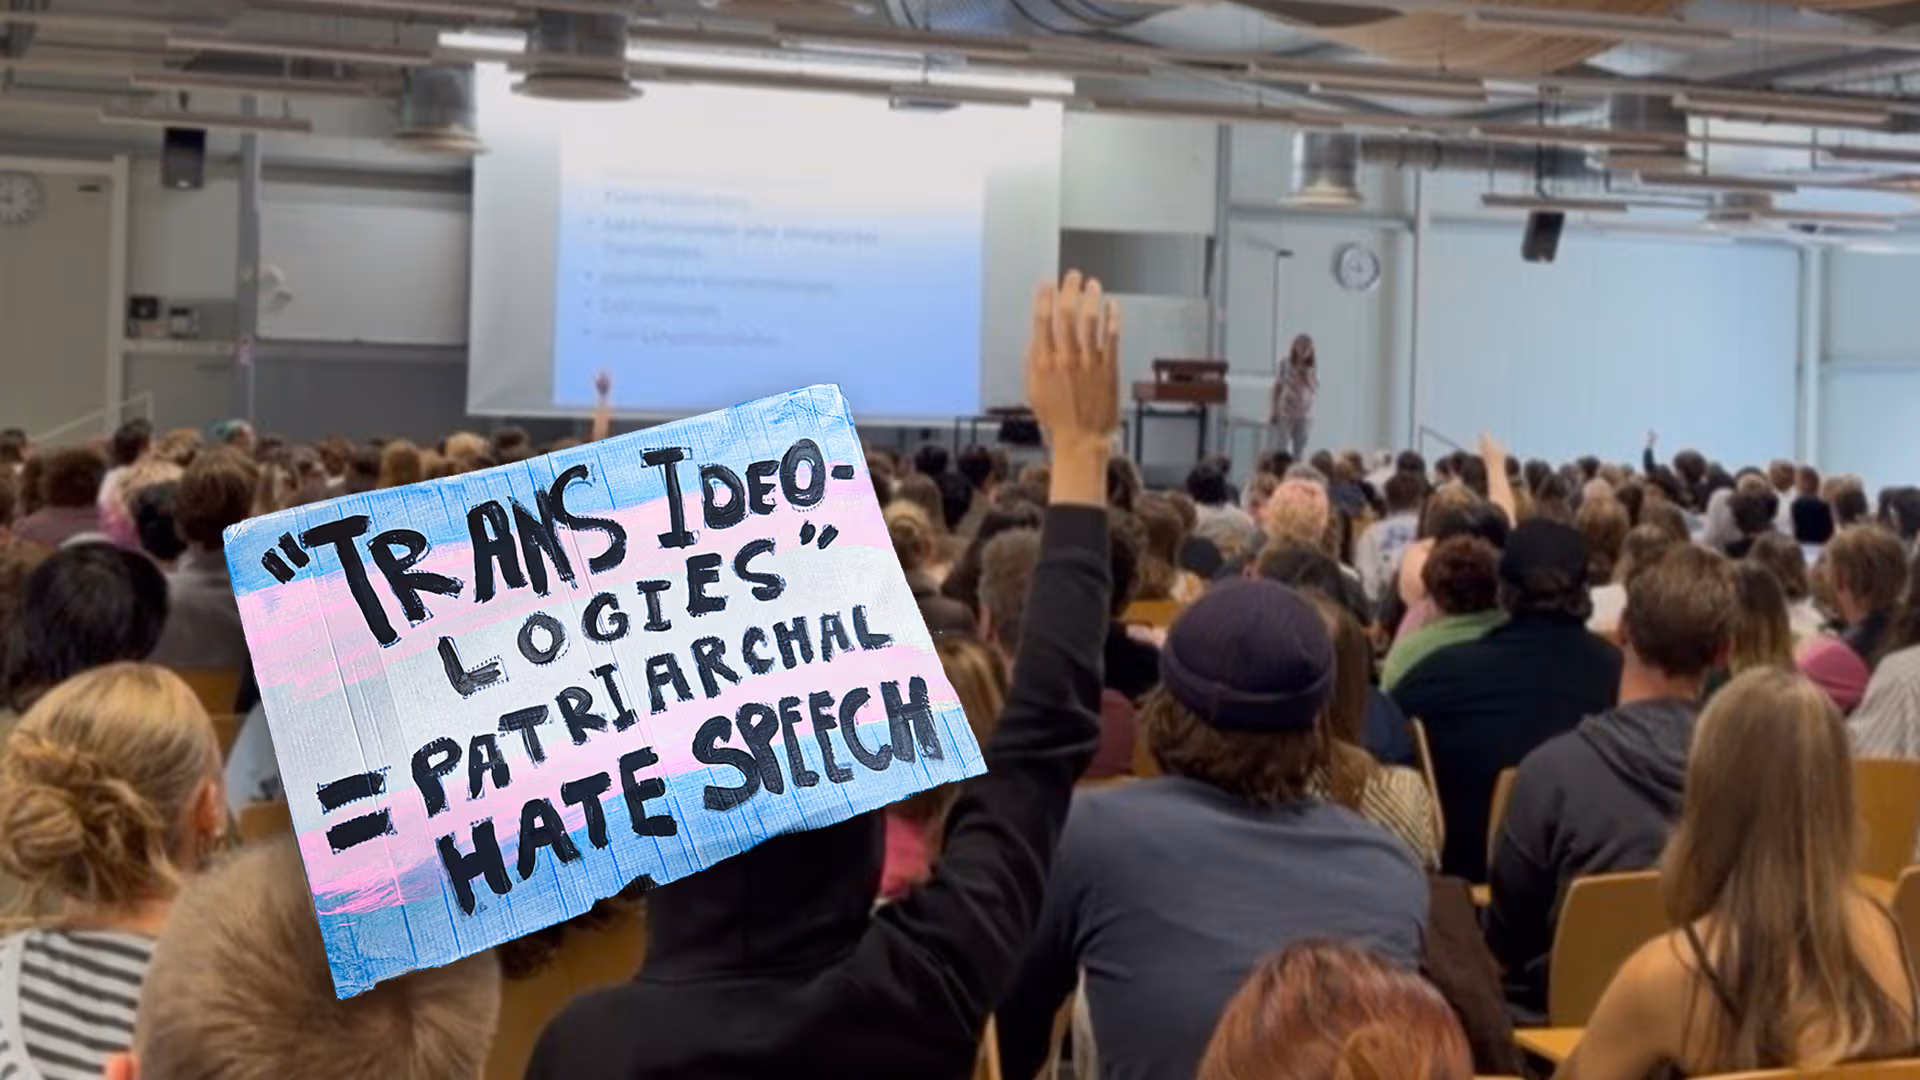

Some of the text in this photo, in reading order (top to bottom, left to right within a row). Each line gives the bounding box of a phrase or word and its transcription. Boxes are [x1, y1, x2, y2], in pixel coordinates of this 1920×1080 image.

[641, 438, 856, 550] IDEO-
[410, 605, 893, 819] PATRIARCHAL
[435, 676, 944, 918] HATE SPEECH
